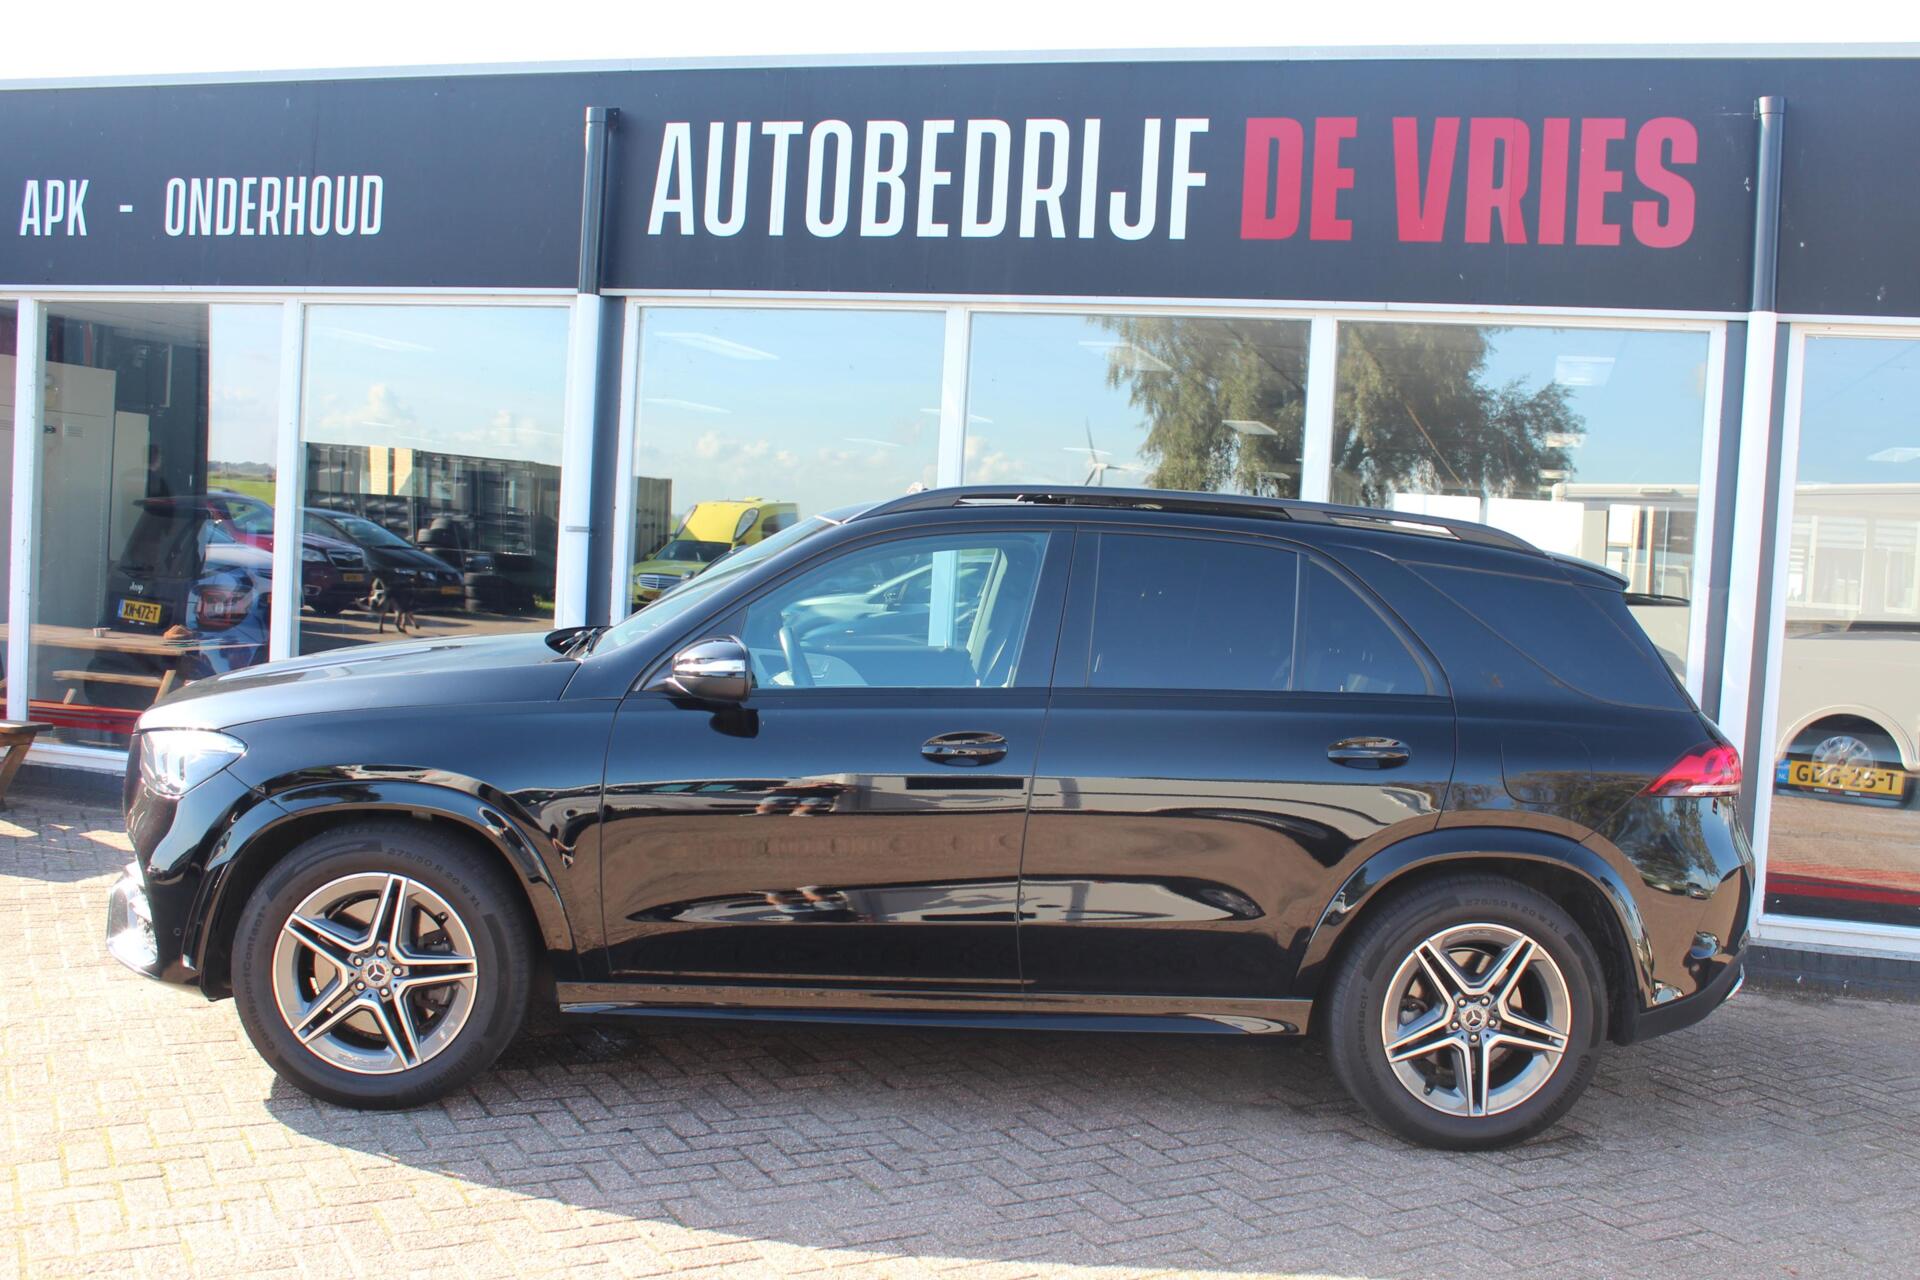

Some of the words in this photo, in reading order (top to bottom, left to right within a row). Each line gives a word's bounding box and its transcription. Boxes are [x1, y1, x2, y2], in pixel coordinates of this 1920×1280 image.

[20, 180, 90, 236] APK
[119, 204, 133, 213] -
[164, 175, 384, 236] ONDERHOUD
[647, 118, 1210, 240] AUTOBEDRIJF
[1240, 117, 1358, 241] DE
[1392, 117, 1699, 249] VRIES
